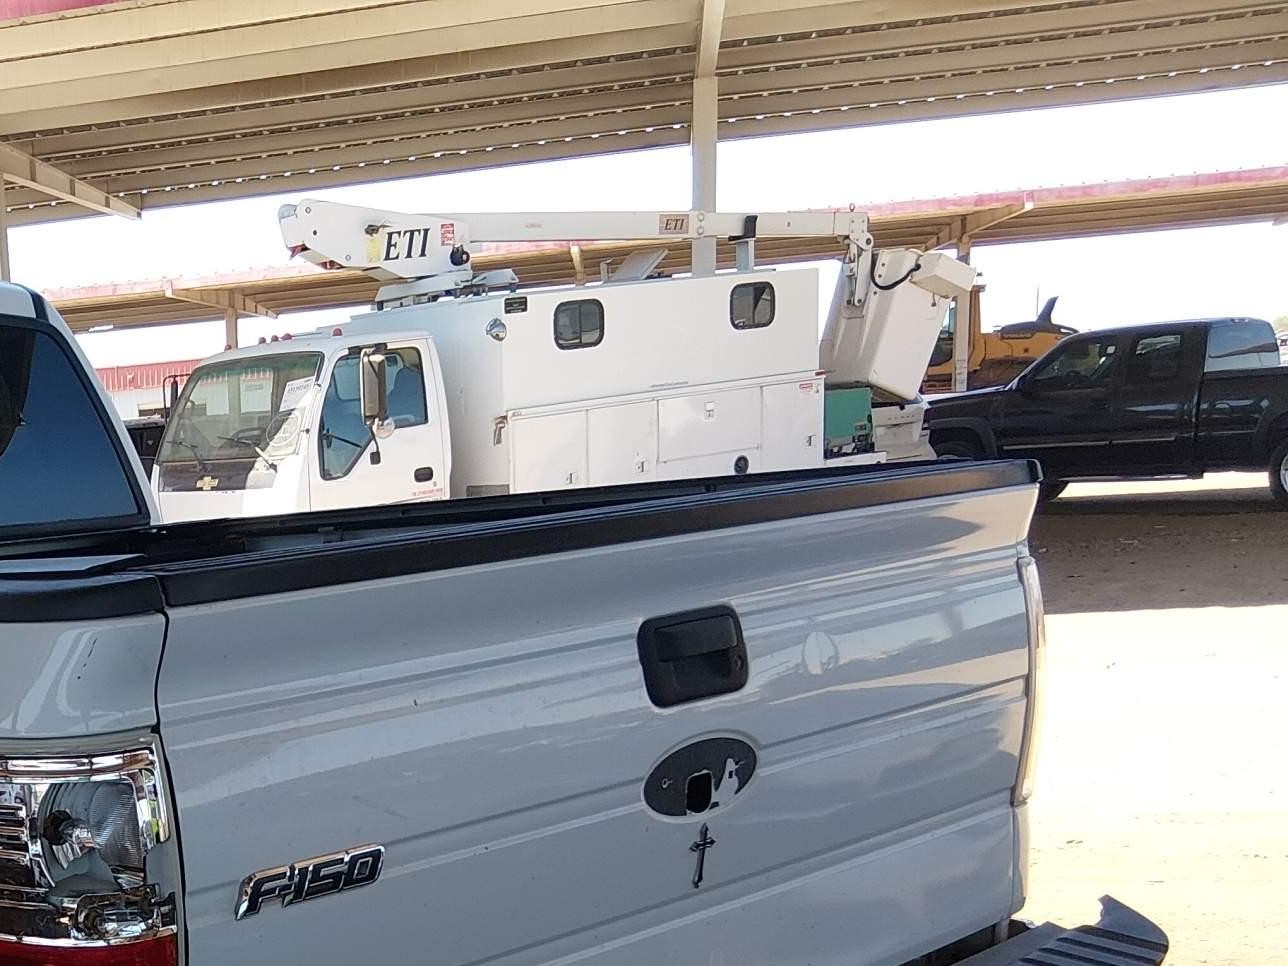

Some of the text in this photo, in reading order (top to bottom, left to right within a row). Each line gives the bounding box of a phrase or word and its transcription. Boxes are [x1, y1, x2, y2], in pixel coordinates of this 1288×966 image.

[664, 218, 685, 231] ETI
[383, 227, 431, 262] ETI
[234, 843, 386, 921] F-150
